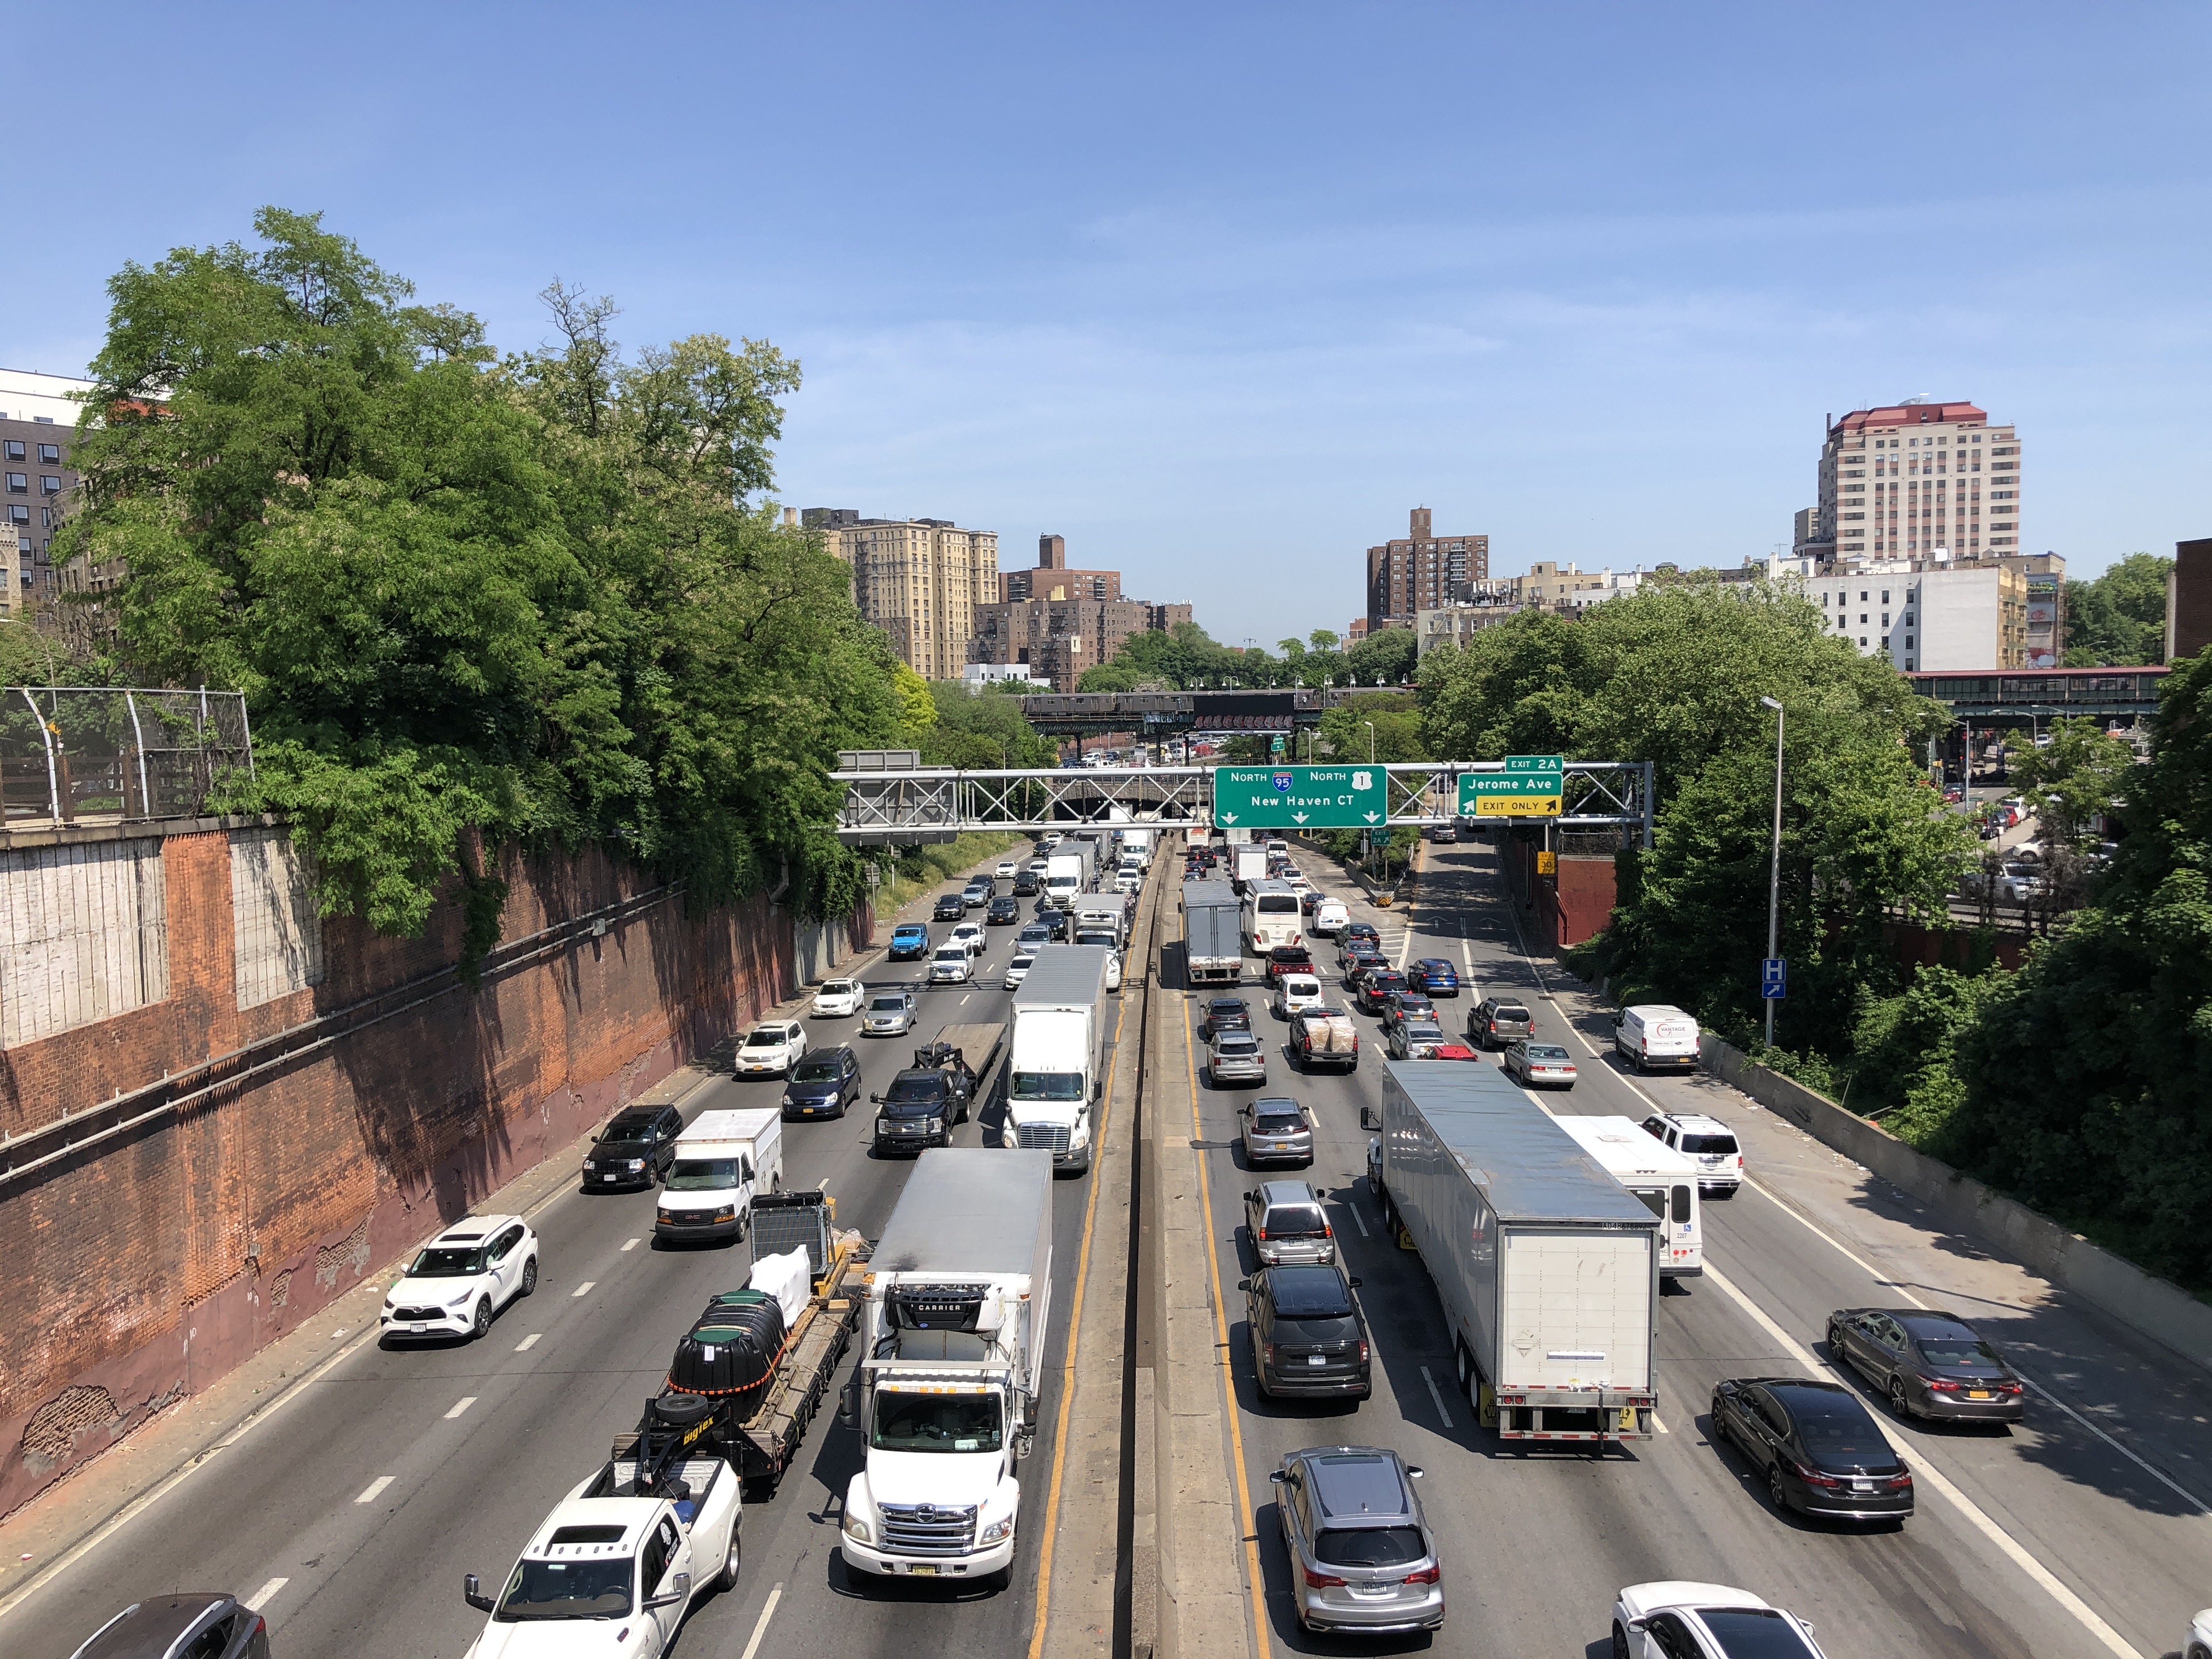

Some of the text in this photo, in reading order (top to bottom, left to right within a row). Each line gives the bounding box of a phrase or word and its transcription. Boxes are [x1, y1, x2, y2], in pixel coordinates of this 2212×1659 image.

[1538, 759, 1557, 769] 2A
[1231, 772, 1267, 782] NORTH
[1310, 771, 1346, 781] NORTH
[1359, 775, 1364, 786] 1
[1276, 778, 1289, 788] 95
[1468, 778, 1552, 789] Jerome Ave
[1251, 795, 1353, 806] New Haven CT
[1766, 961, 1782, 980] H
